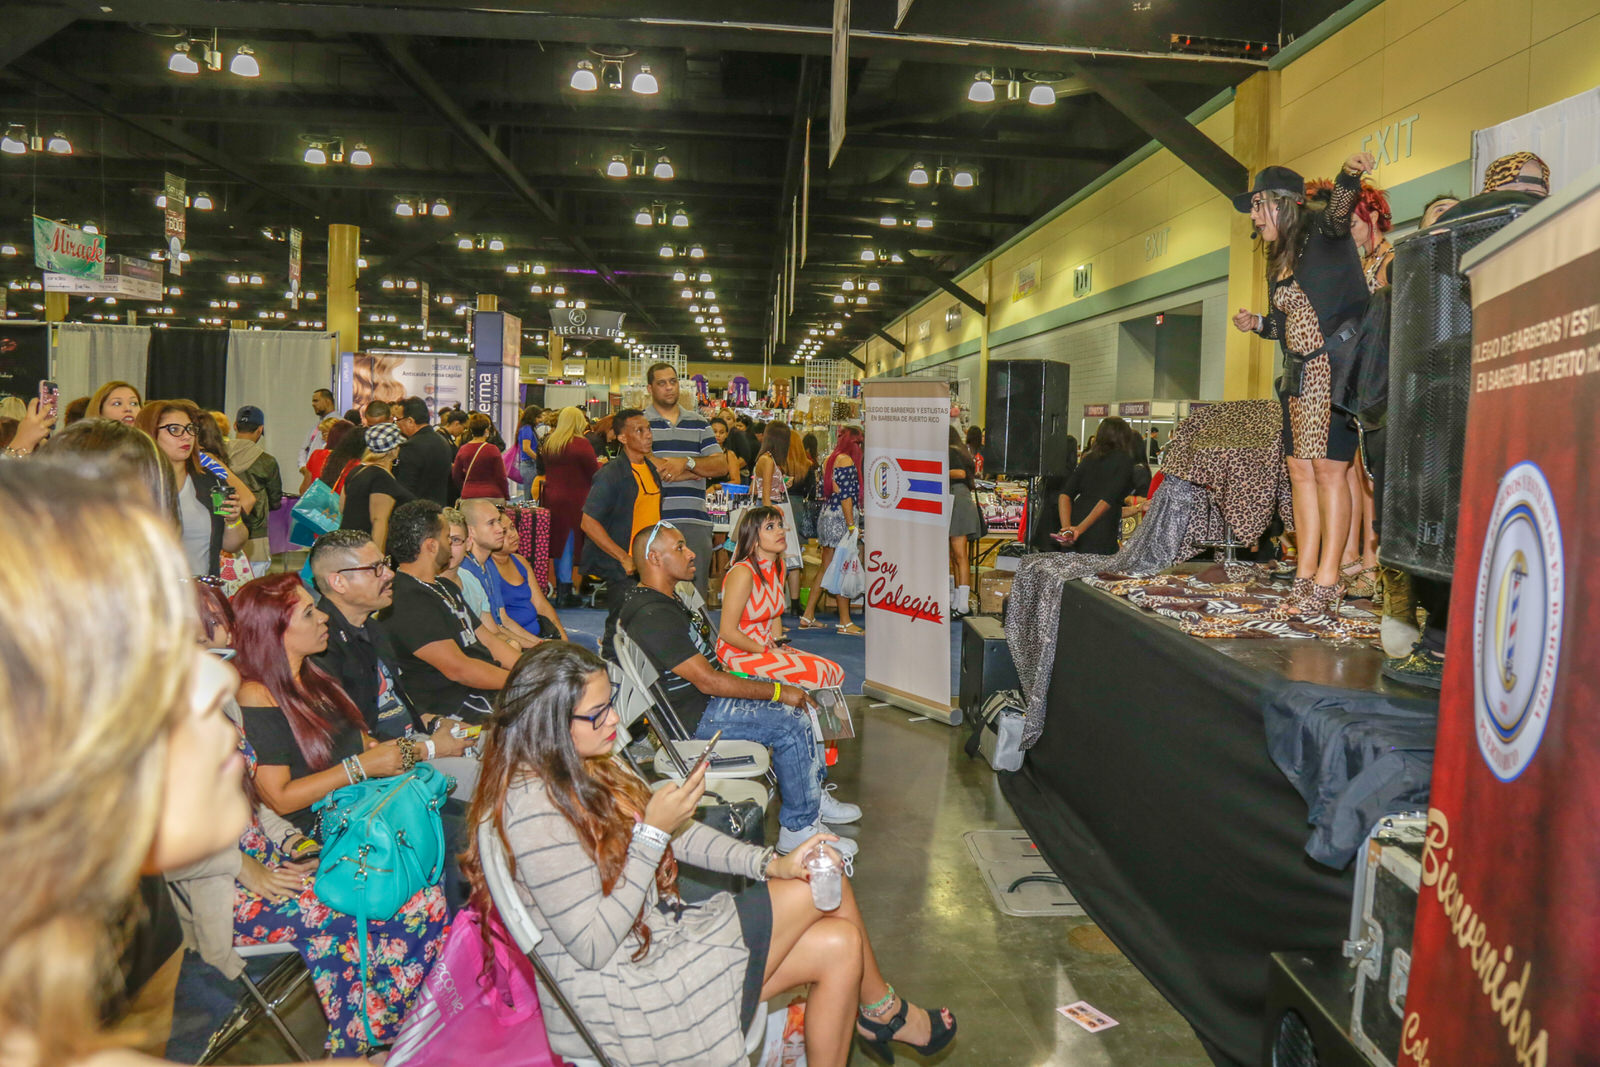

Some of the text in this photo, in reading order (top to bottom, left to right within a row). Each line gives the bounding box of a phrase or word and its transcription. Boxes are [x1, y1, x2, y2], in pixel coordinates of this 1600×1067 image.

[1361, 113, 1420, 174] EXIT
[46, 227, 103, 264] Miracle
[1145, 227, 1171, 263] EXIT
[1541, 348, 1587, 382] PUERTO
[479, 373, 491, 416] erma
[920, 407, 949, 415] ESTILISTAS
[867, 550, 898, 582] Soy
[867, 576, 942, 623] Colegio
